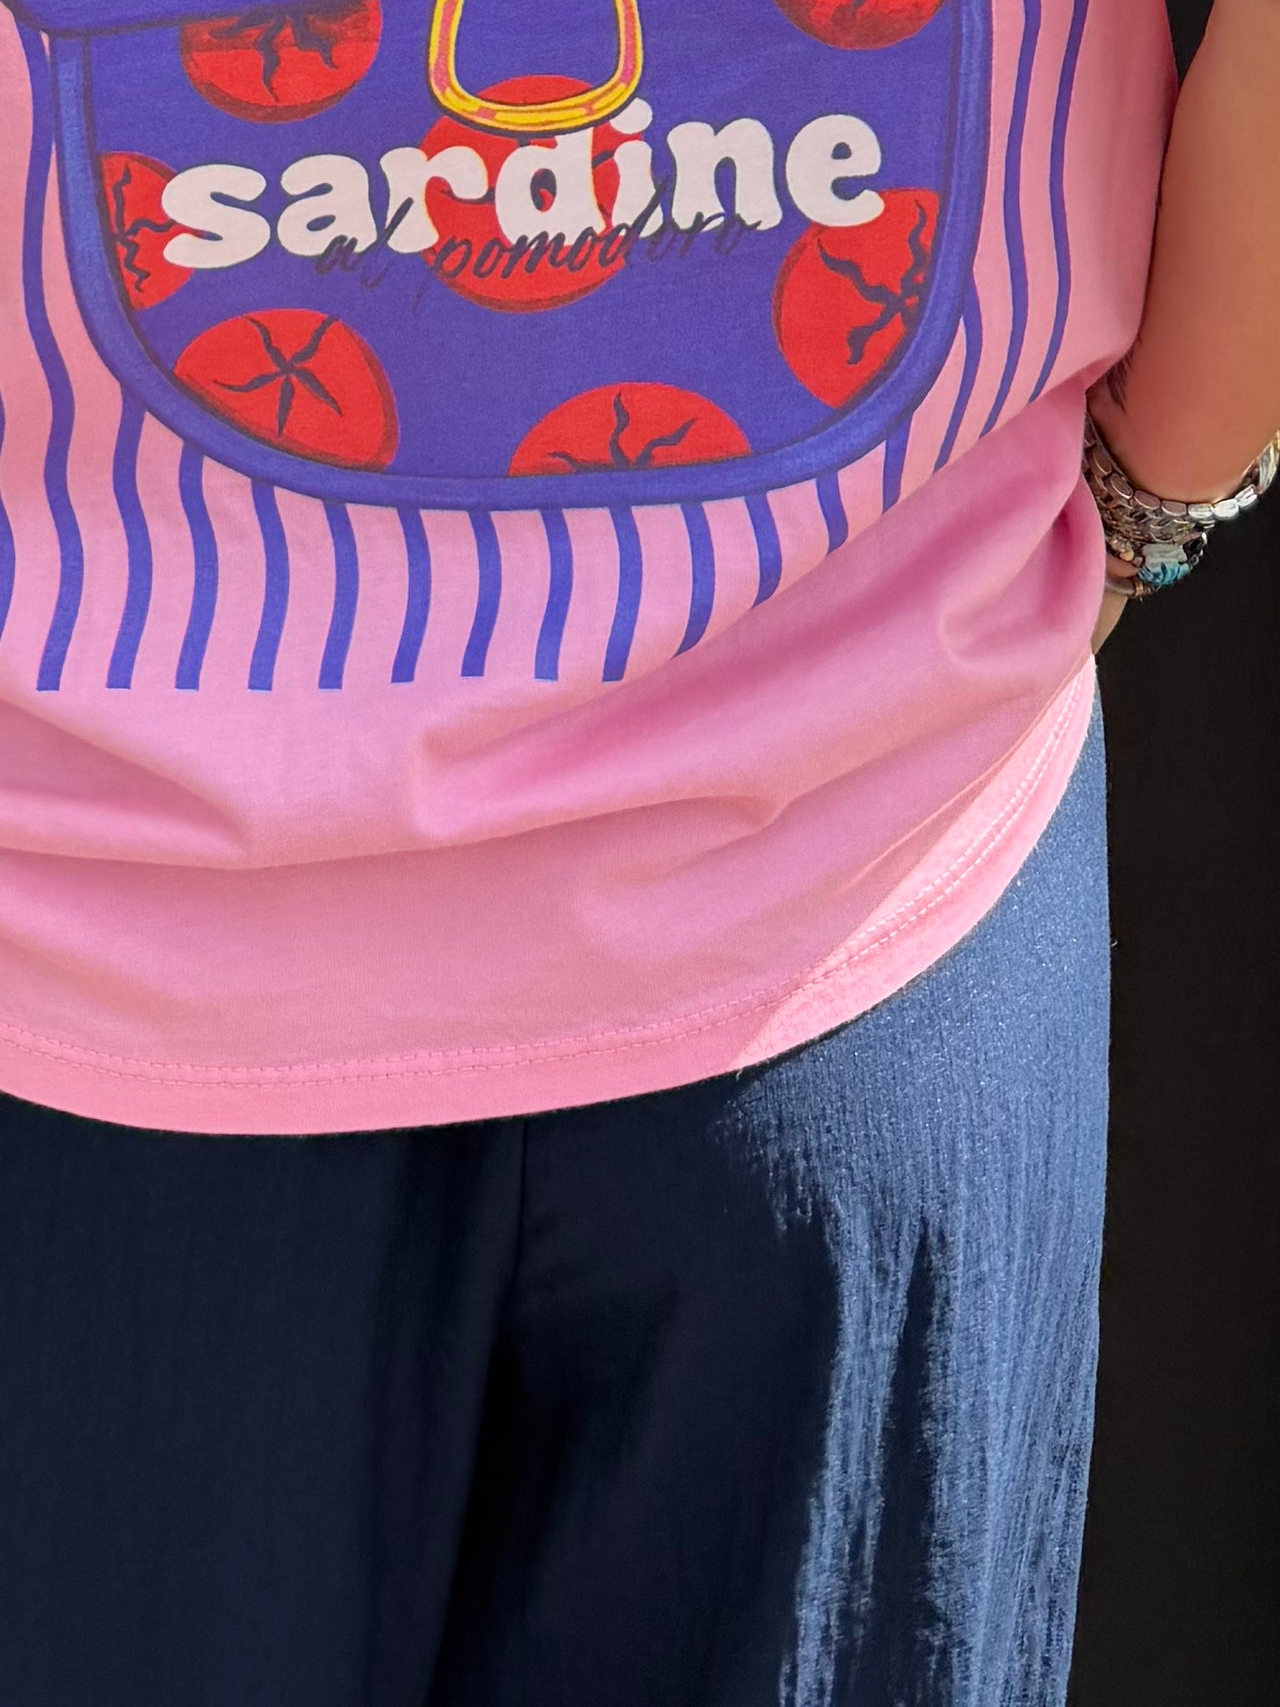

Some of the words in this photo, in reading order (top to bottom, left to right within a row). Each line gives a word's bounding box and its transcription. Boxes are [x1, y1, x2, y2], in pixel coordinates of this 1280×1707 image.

[163, 98, 884, 270] sardine
[315, 196, 414, 289] al
[412, 173, 763, 316] pomodoro
